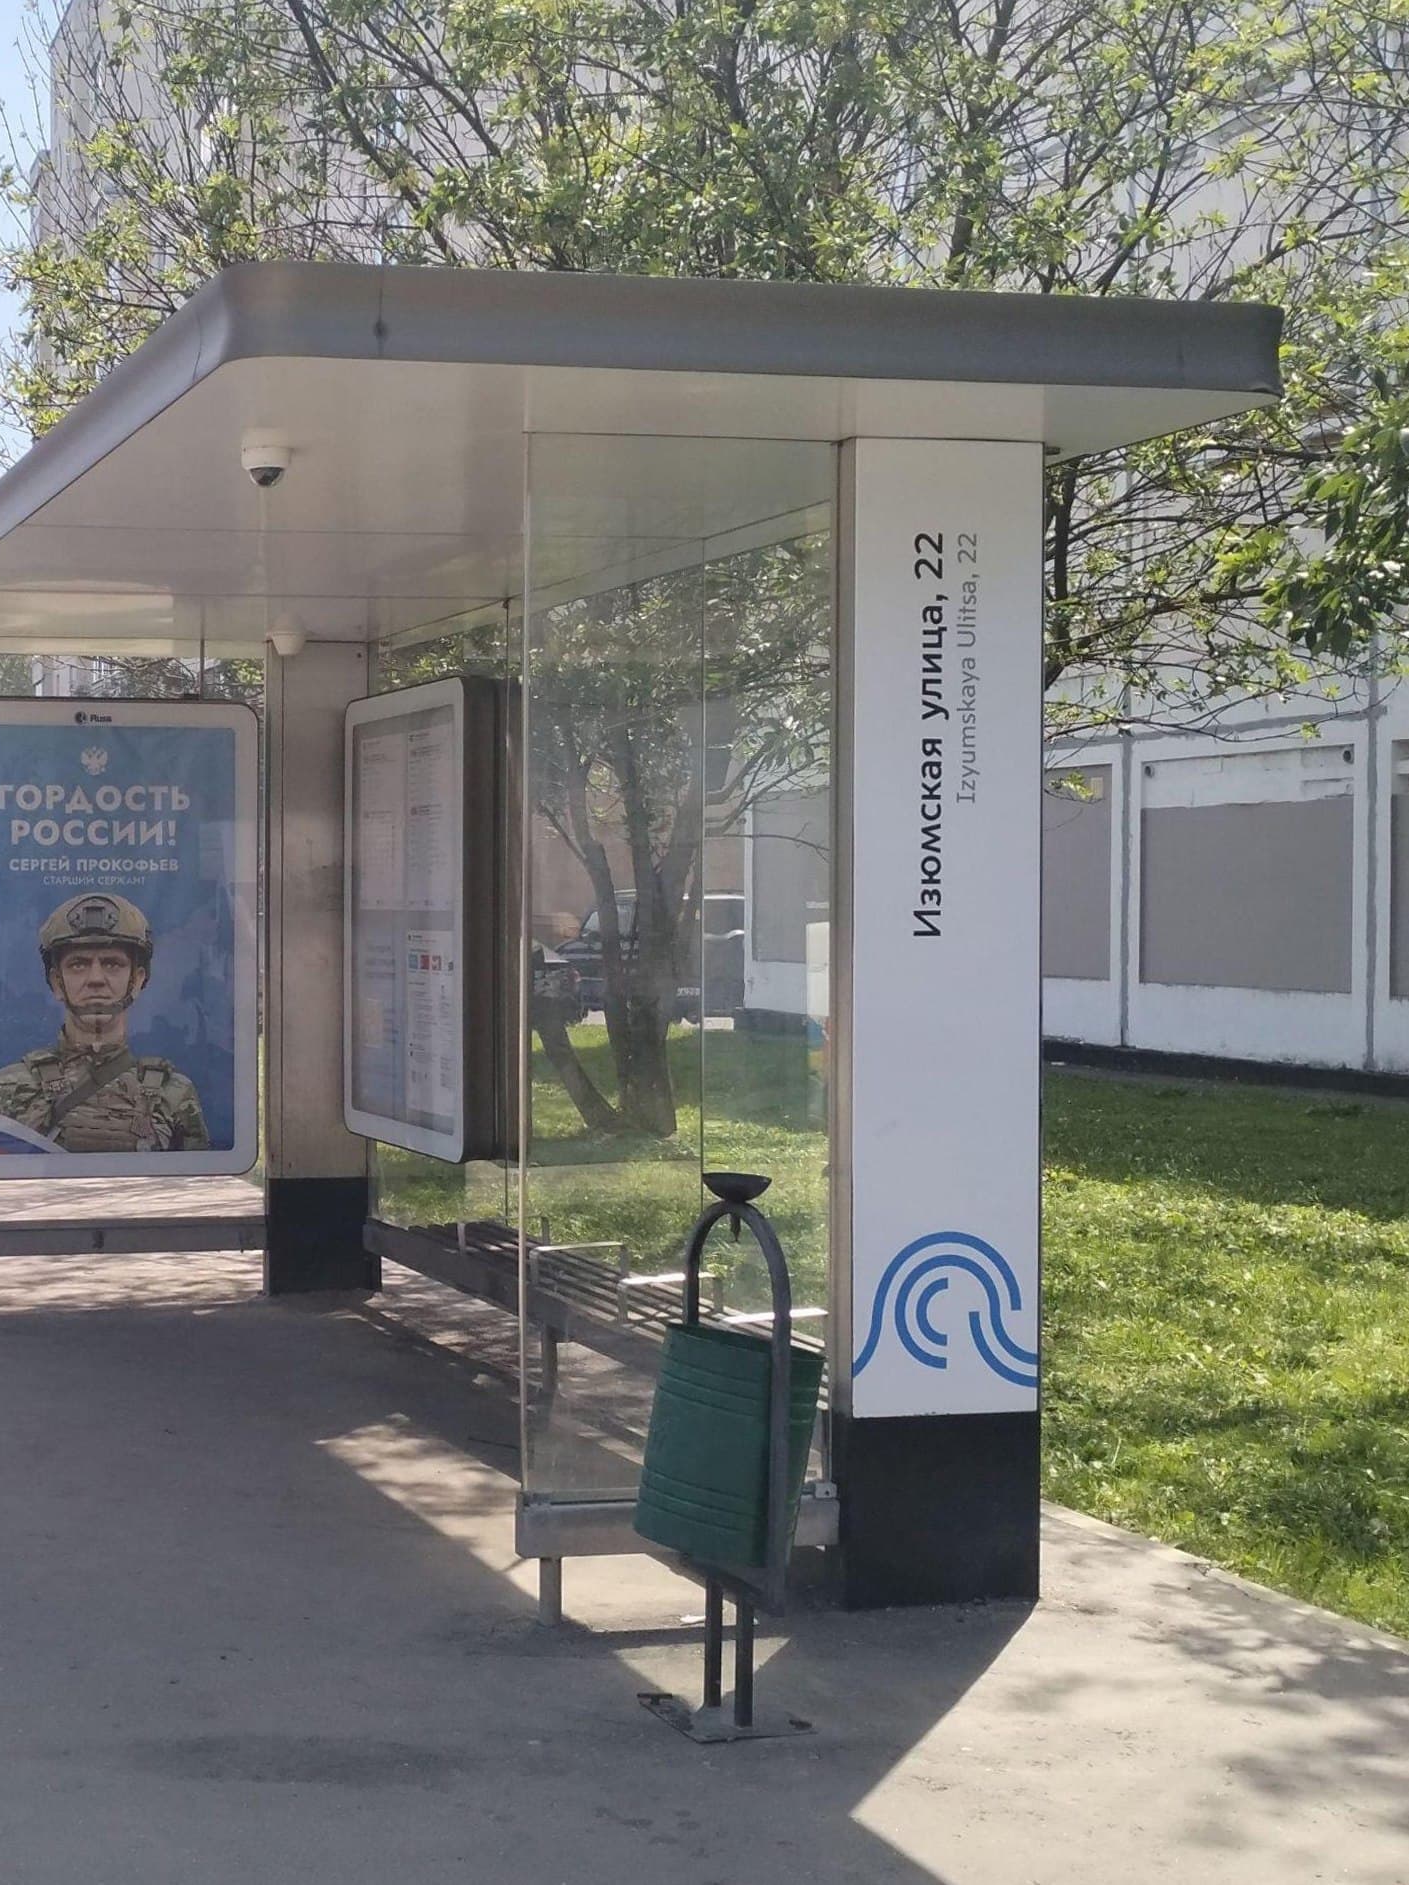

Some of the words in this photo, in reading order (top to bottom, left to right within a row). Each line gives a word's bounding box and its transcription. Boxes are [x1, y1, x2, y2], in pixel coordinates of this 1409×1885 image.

[914, 532, 944, 580] 22
[957, 532, 978, 564] 22
[956, 572, 980, 648] Ulitsa,
[920, 593, 949, 720] улица,
[956, 656, 982, 804] Izyumskaya
[10, 819, 177, 846] РОССИИ!
[912, 737, 943, 937] Изюмская
[9, 856, 70, 871] СЕРГЕЙ
[76, 859, 179, 871] ПРОКОФЬЕВ
[97, 876, 145, 886] СЕРЖАНТ
